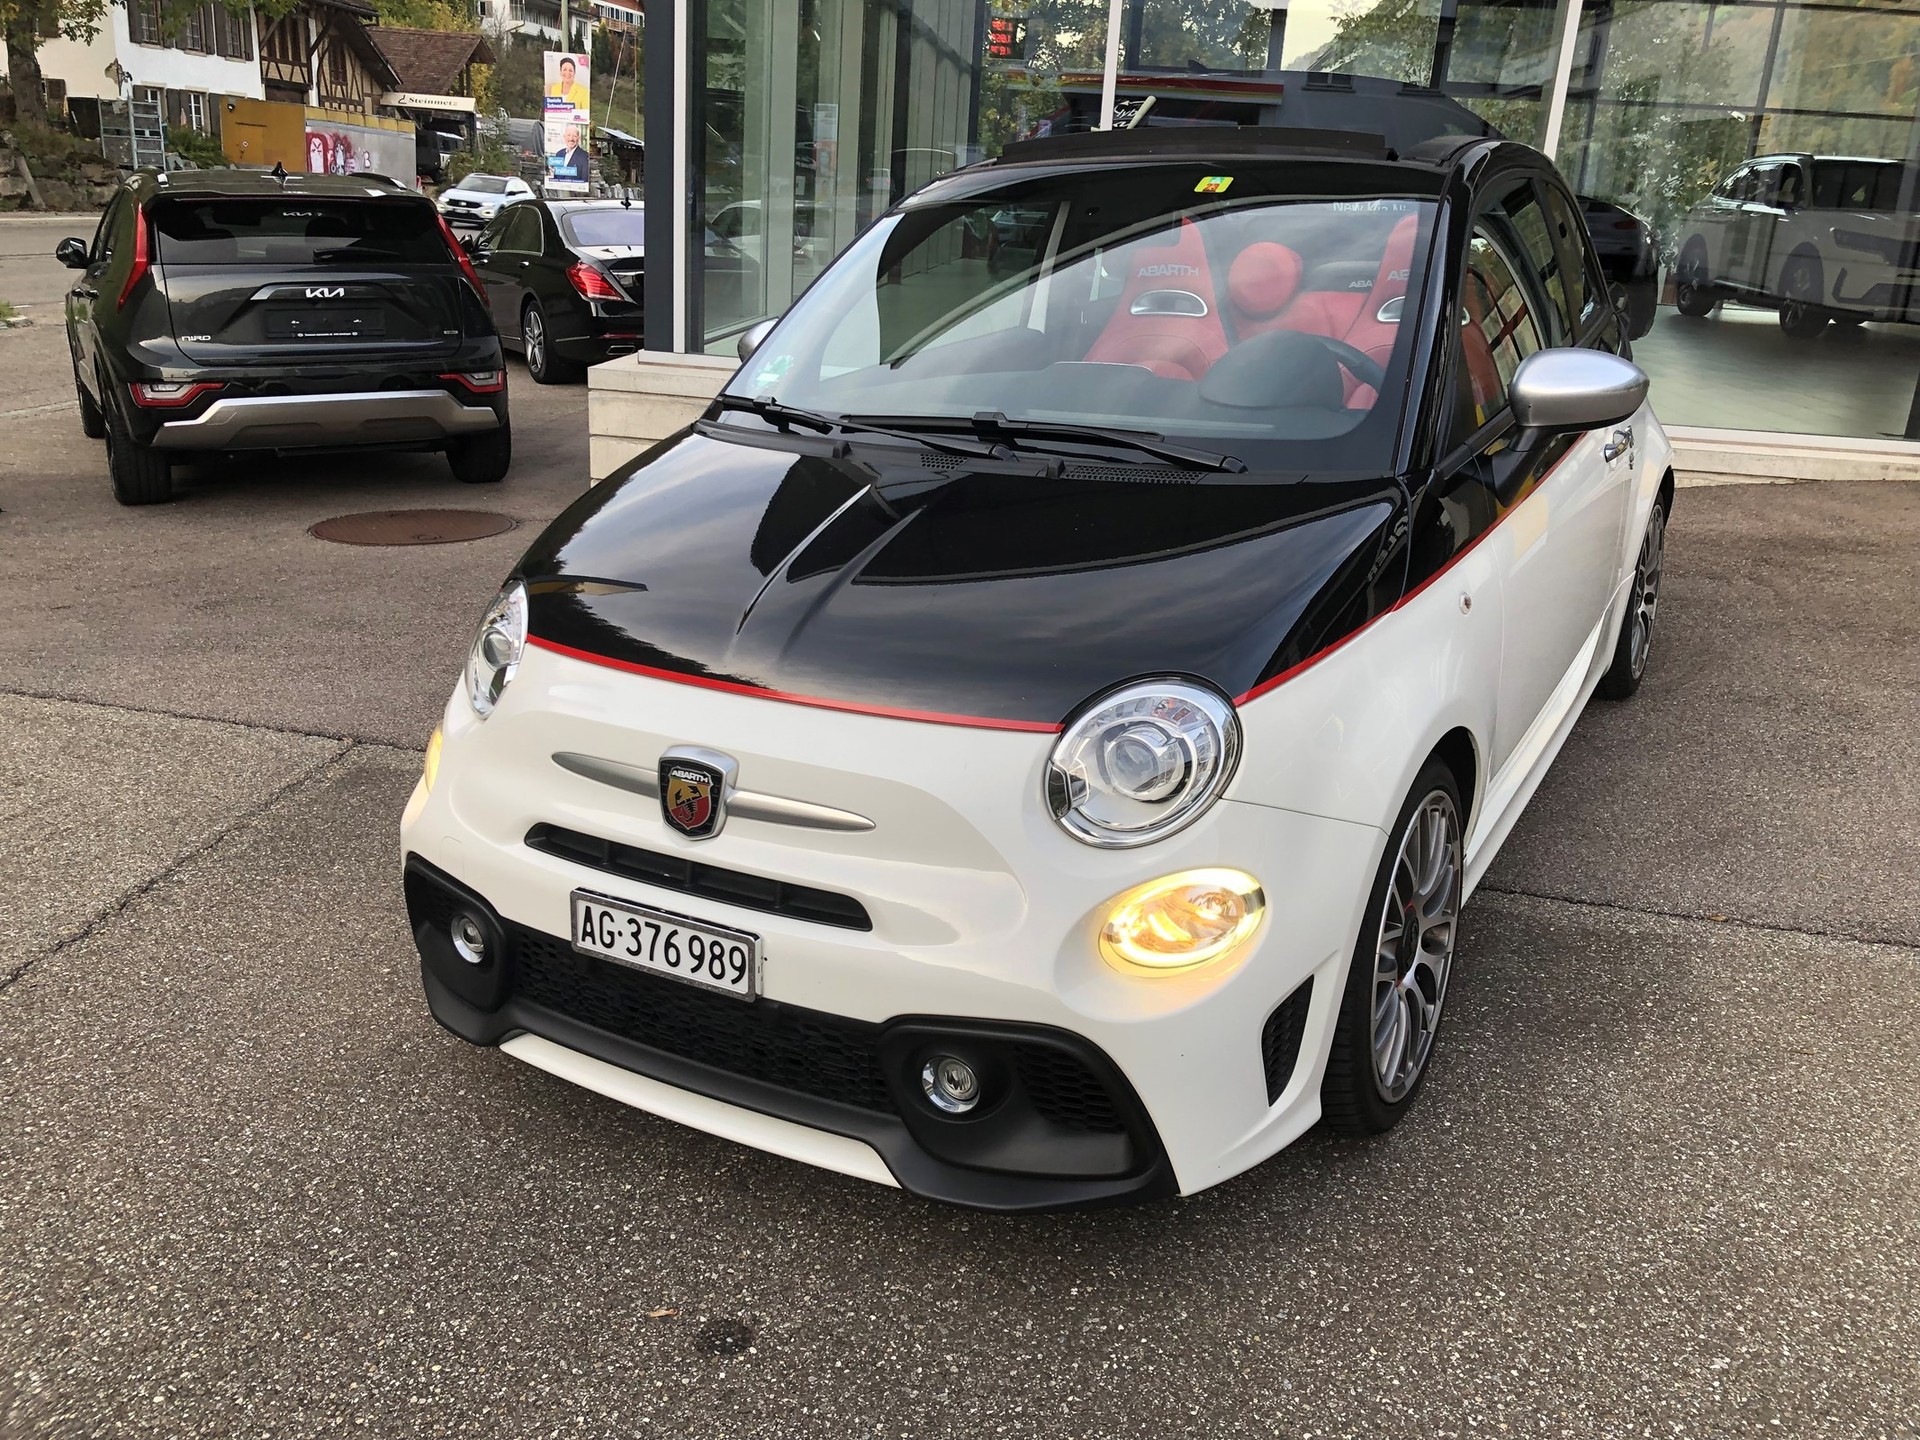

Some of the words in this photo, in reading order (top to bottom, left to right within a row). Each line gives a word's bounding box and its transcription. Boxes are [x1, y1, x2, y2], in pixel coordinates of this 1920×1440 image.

[1137, 263, 1200, 278] ABARTH
[1348, 279, 1374, 288] ABA
[305, 287, 345, 298] KIA
[671, 769, 710, 784] ABARTH
